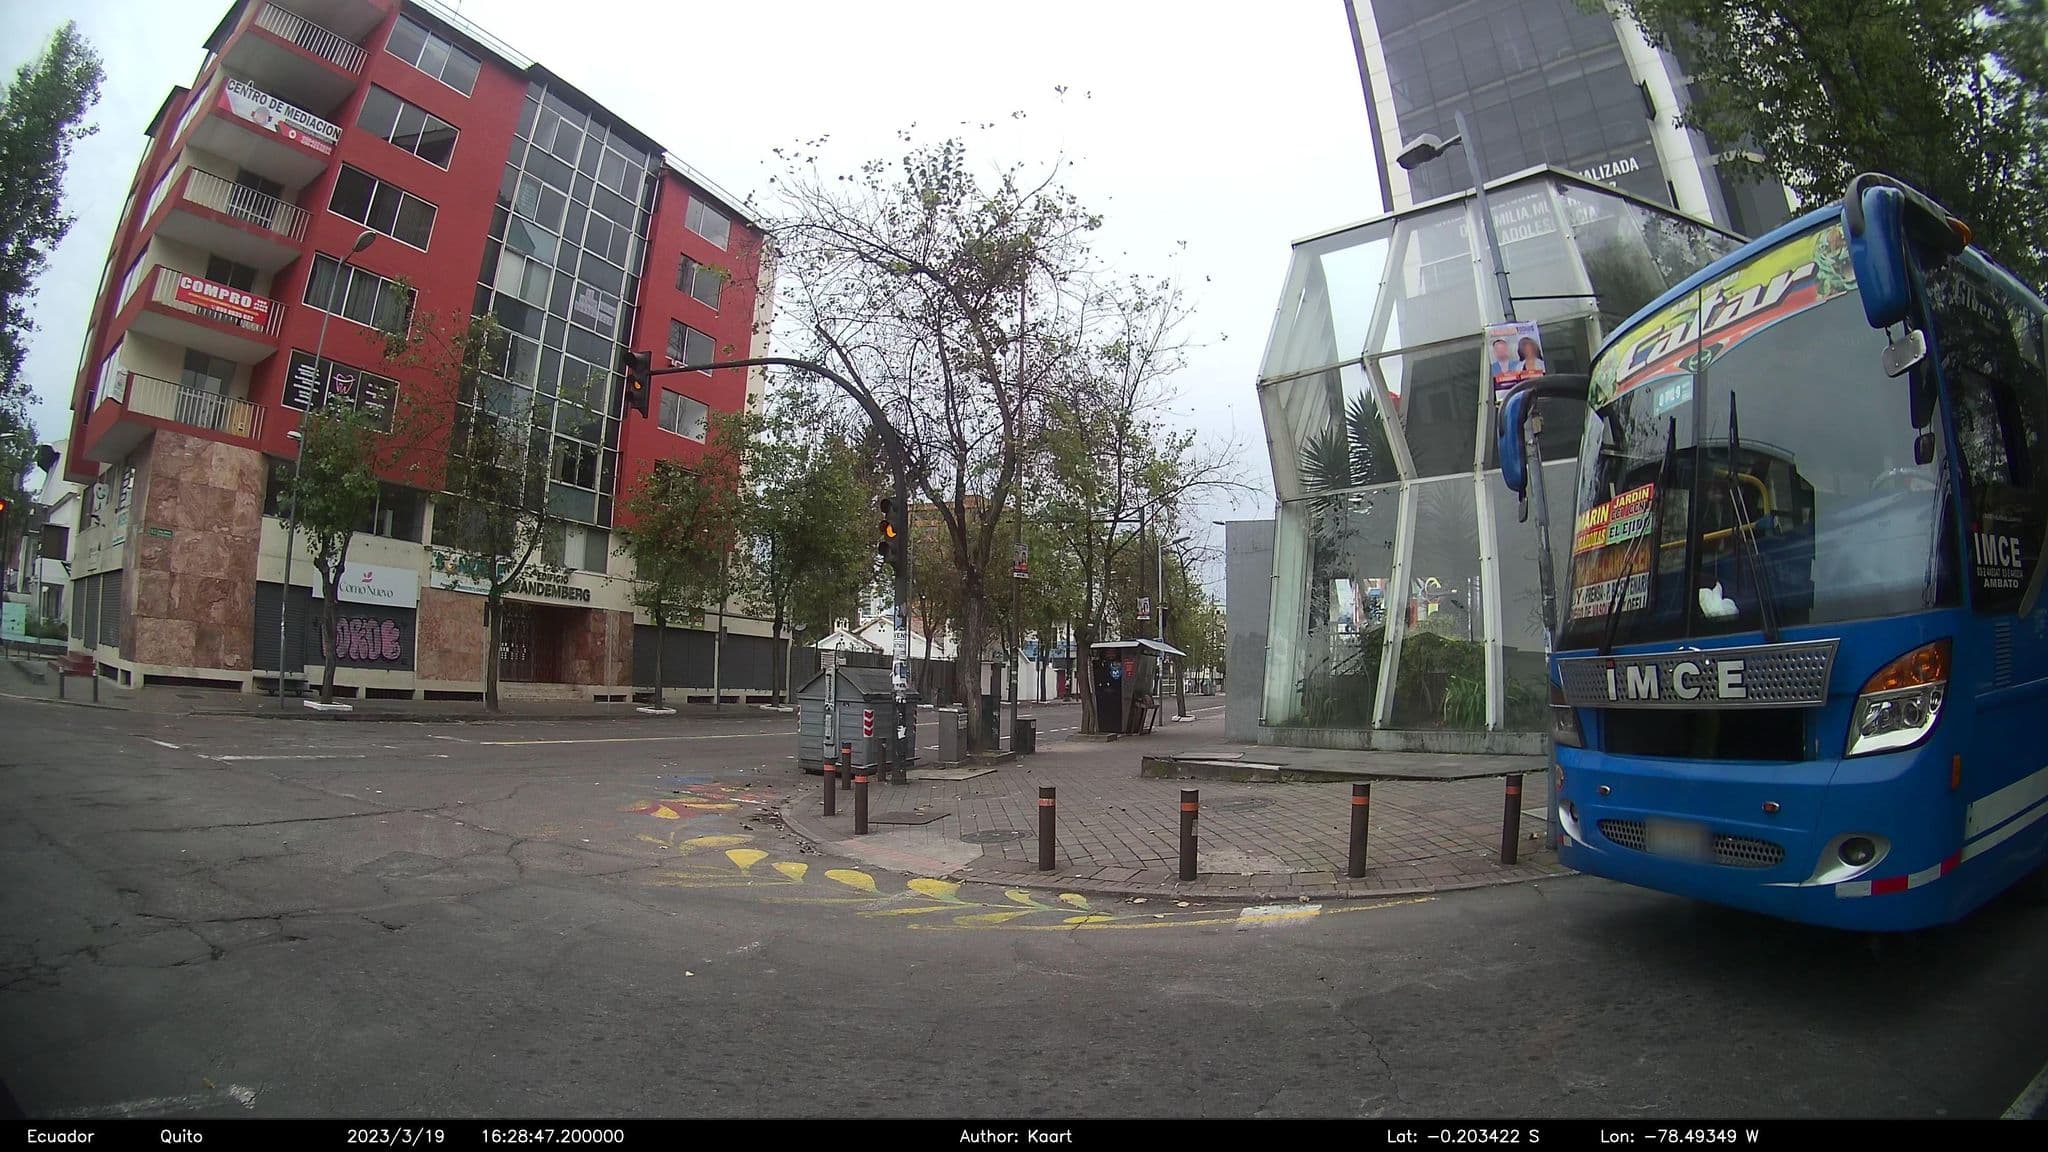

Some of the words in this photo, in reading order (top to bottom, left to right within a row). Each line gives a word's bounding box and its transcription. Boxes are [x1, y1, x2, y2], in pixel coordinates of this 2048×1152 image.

[227, 79, 268, 106] CENTRO
[268, 99, 285, 114] DE
[284, 105, 342, 140] MEDIACION
[1579, 156, 1639, 181] ALIZADA
[180, 276, 253, 308] COMPRO
[1613, 487, 1650, 509] JARDIN
[1609, 526, 1620, 538] EL
[1973, 531, 2022, 568] IMCE
[536, 571, 570, 585] EDIFICIO
[1983, 578, 2020, 589] AMBATO
[339, 580, 367, 594] Como
[366, 583, 394, 599] Nuevo
